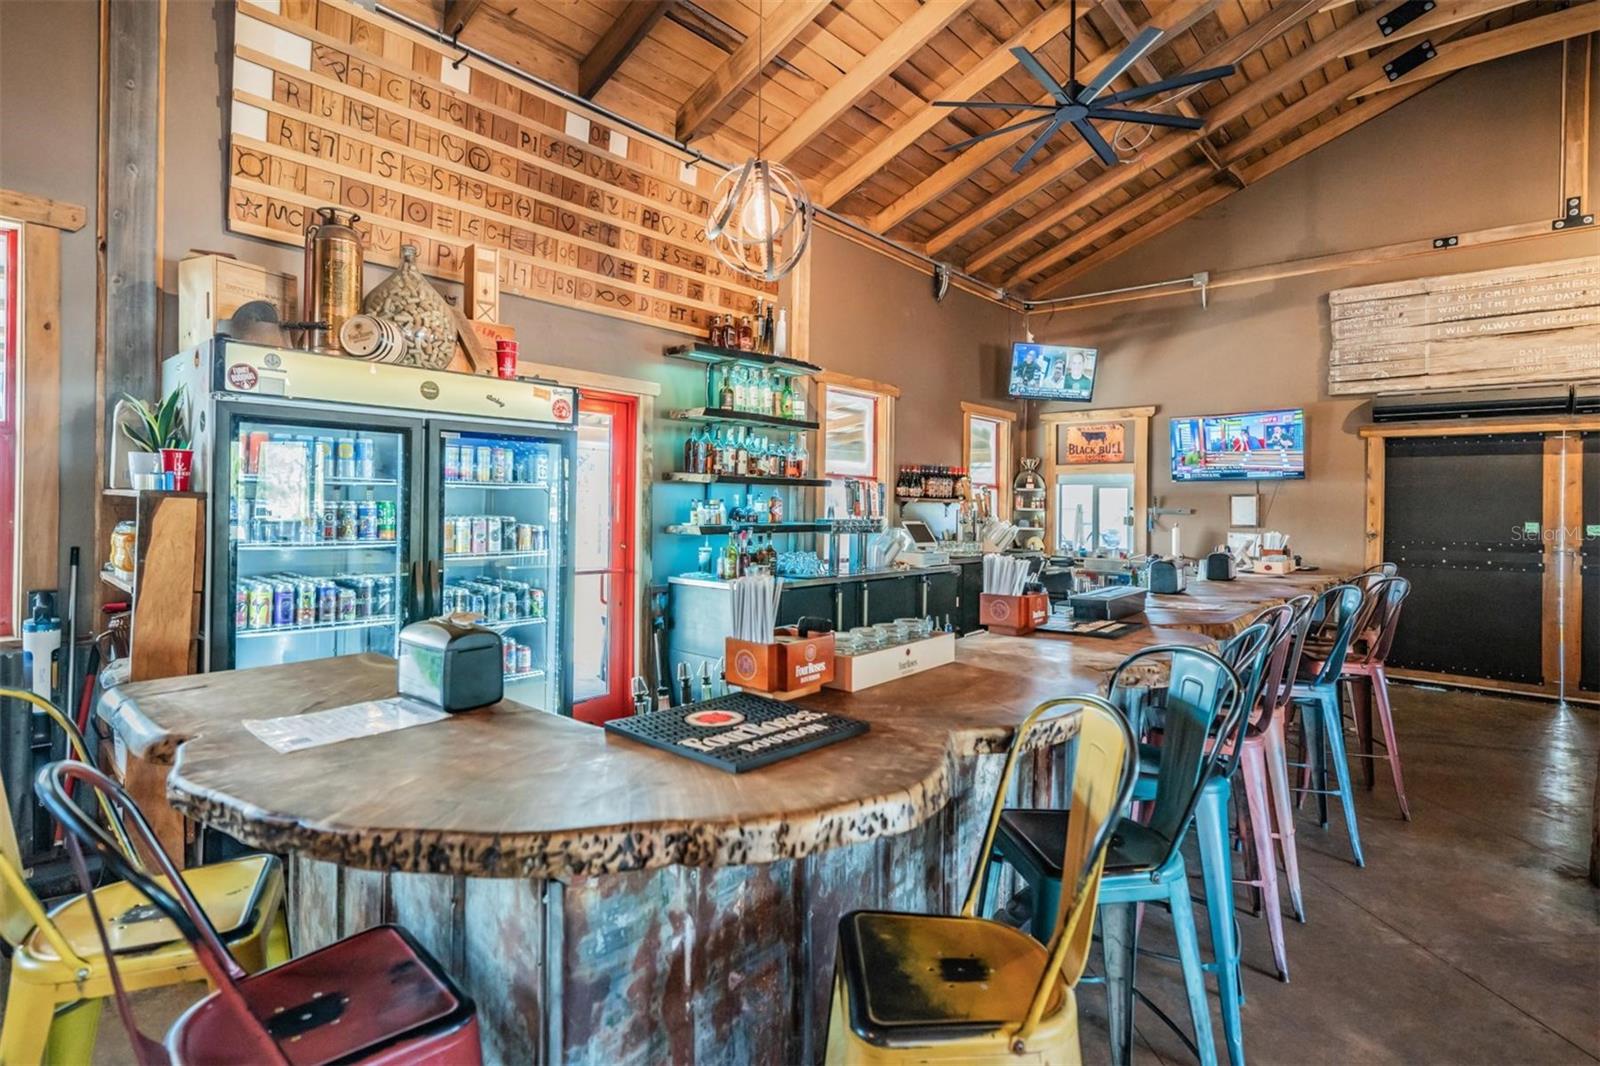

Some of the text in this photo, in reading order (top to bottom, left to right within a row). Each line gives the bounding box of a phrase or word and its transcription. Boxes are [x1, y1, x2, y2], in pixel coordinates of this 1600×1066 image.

[1438, 304, 1465, 314] WHO
[1469, 303, 1482, 311] IN
[1445, 325, 1474, 335] WILL
[1479, 319, 1527, 332] ALWAYS
[1068, 443, 1097, 456] BLACK
